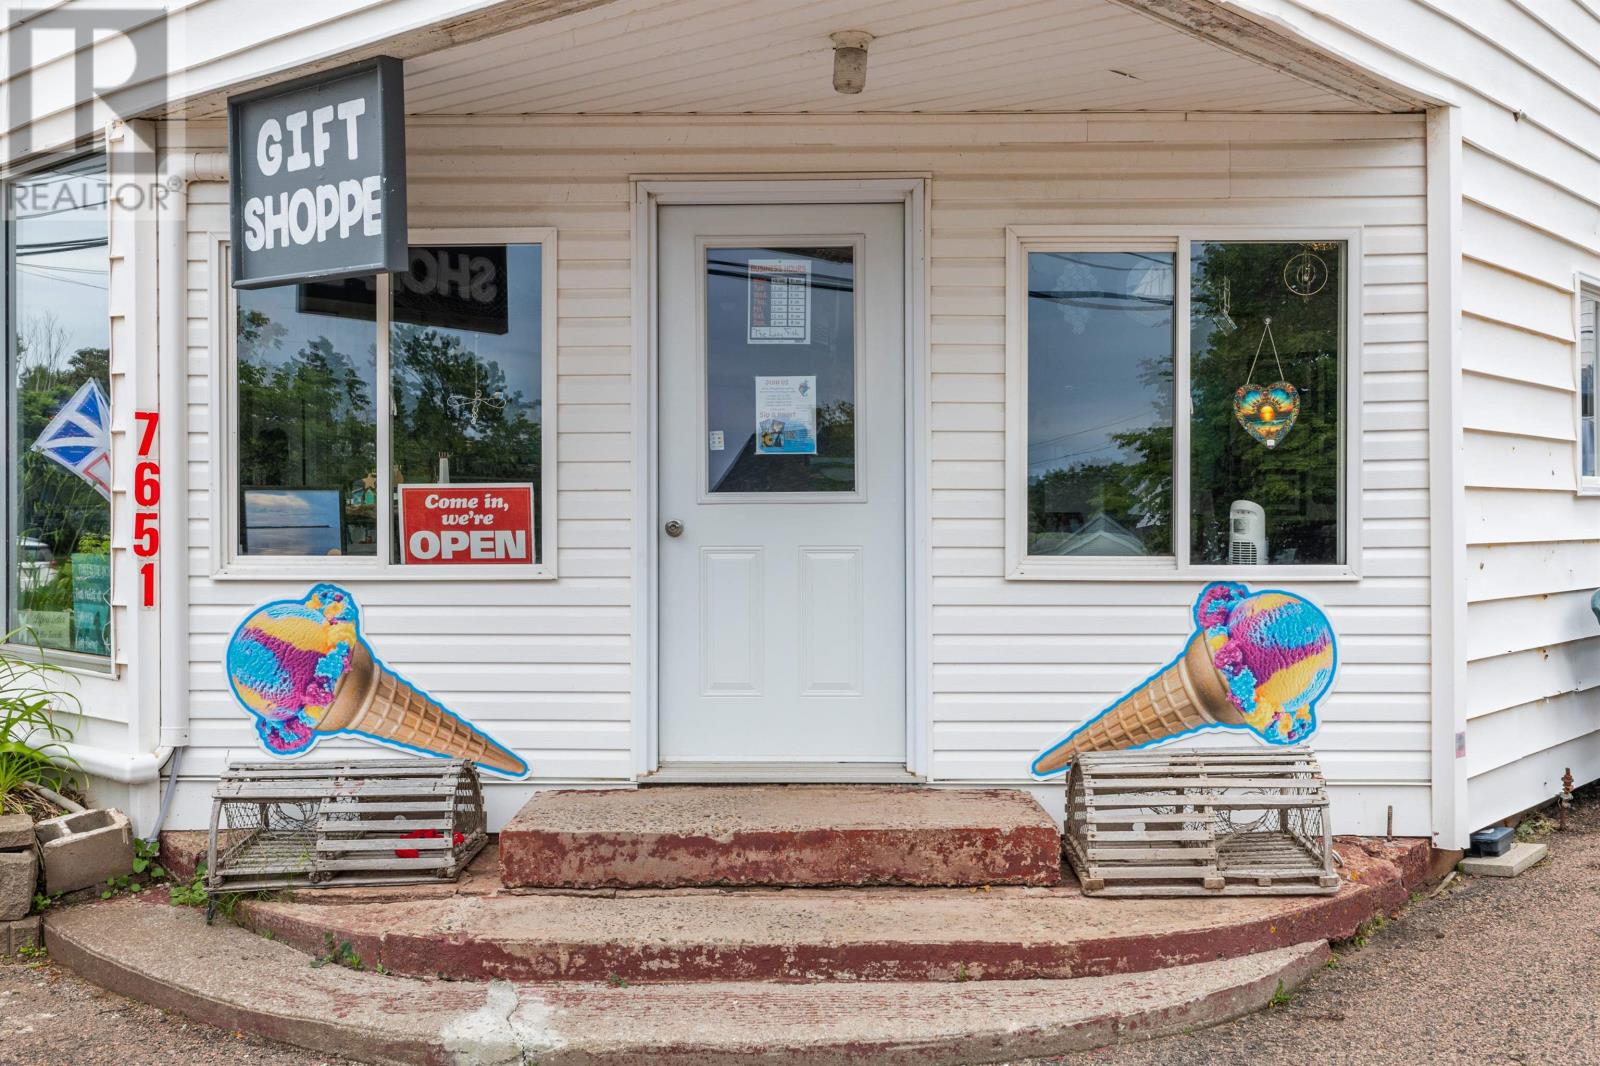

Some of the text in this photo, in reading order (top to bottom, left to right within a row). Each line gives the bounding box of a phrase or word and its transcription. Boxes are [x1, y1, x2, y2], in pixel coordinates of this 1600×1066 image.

[257, 97, 365, 177] GIFT
[244, 176, 383, 252] SHOPPE
[133, 412, 161, 607] 7651
[425, 493, 509, 511] Come in,
[441, 511, 494, 525] we're
[409, 530, 526, 560] OPEN
